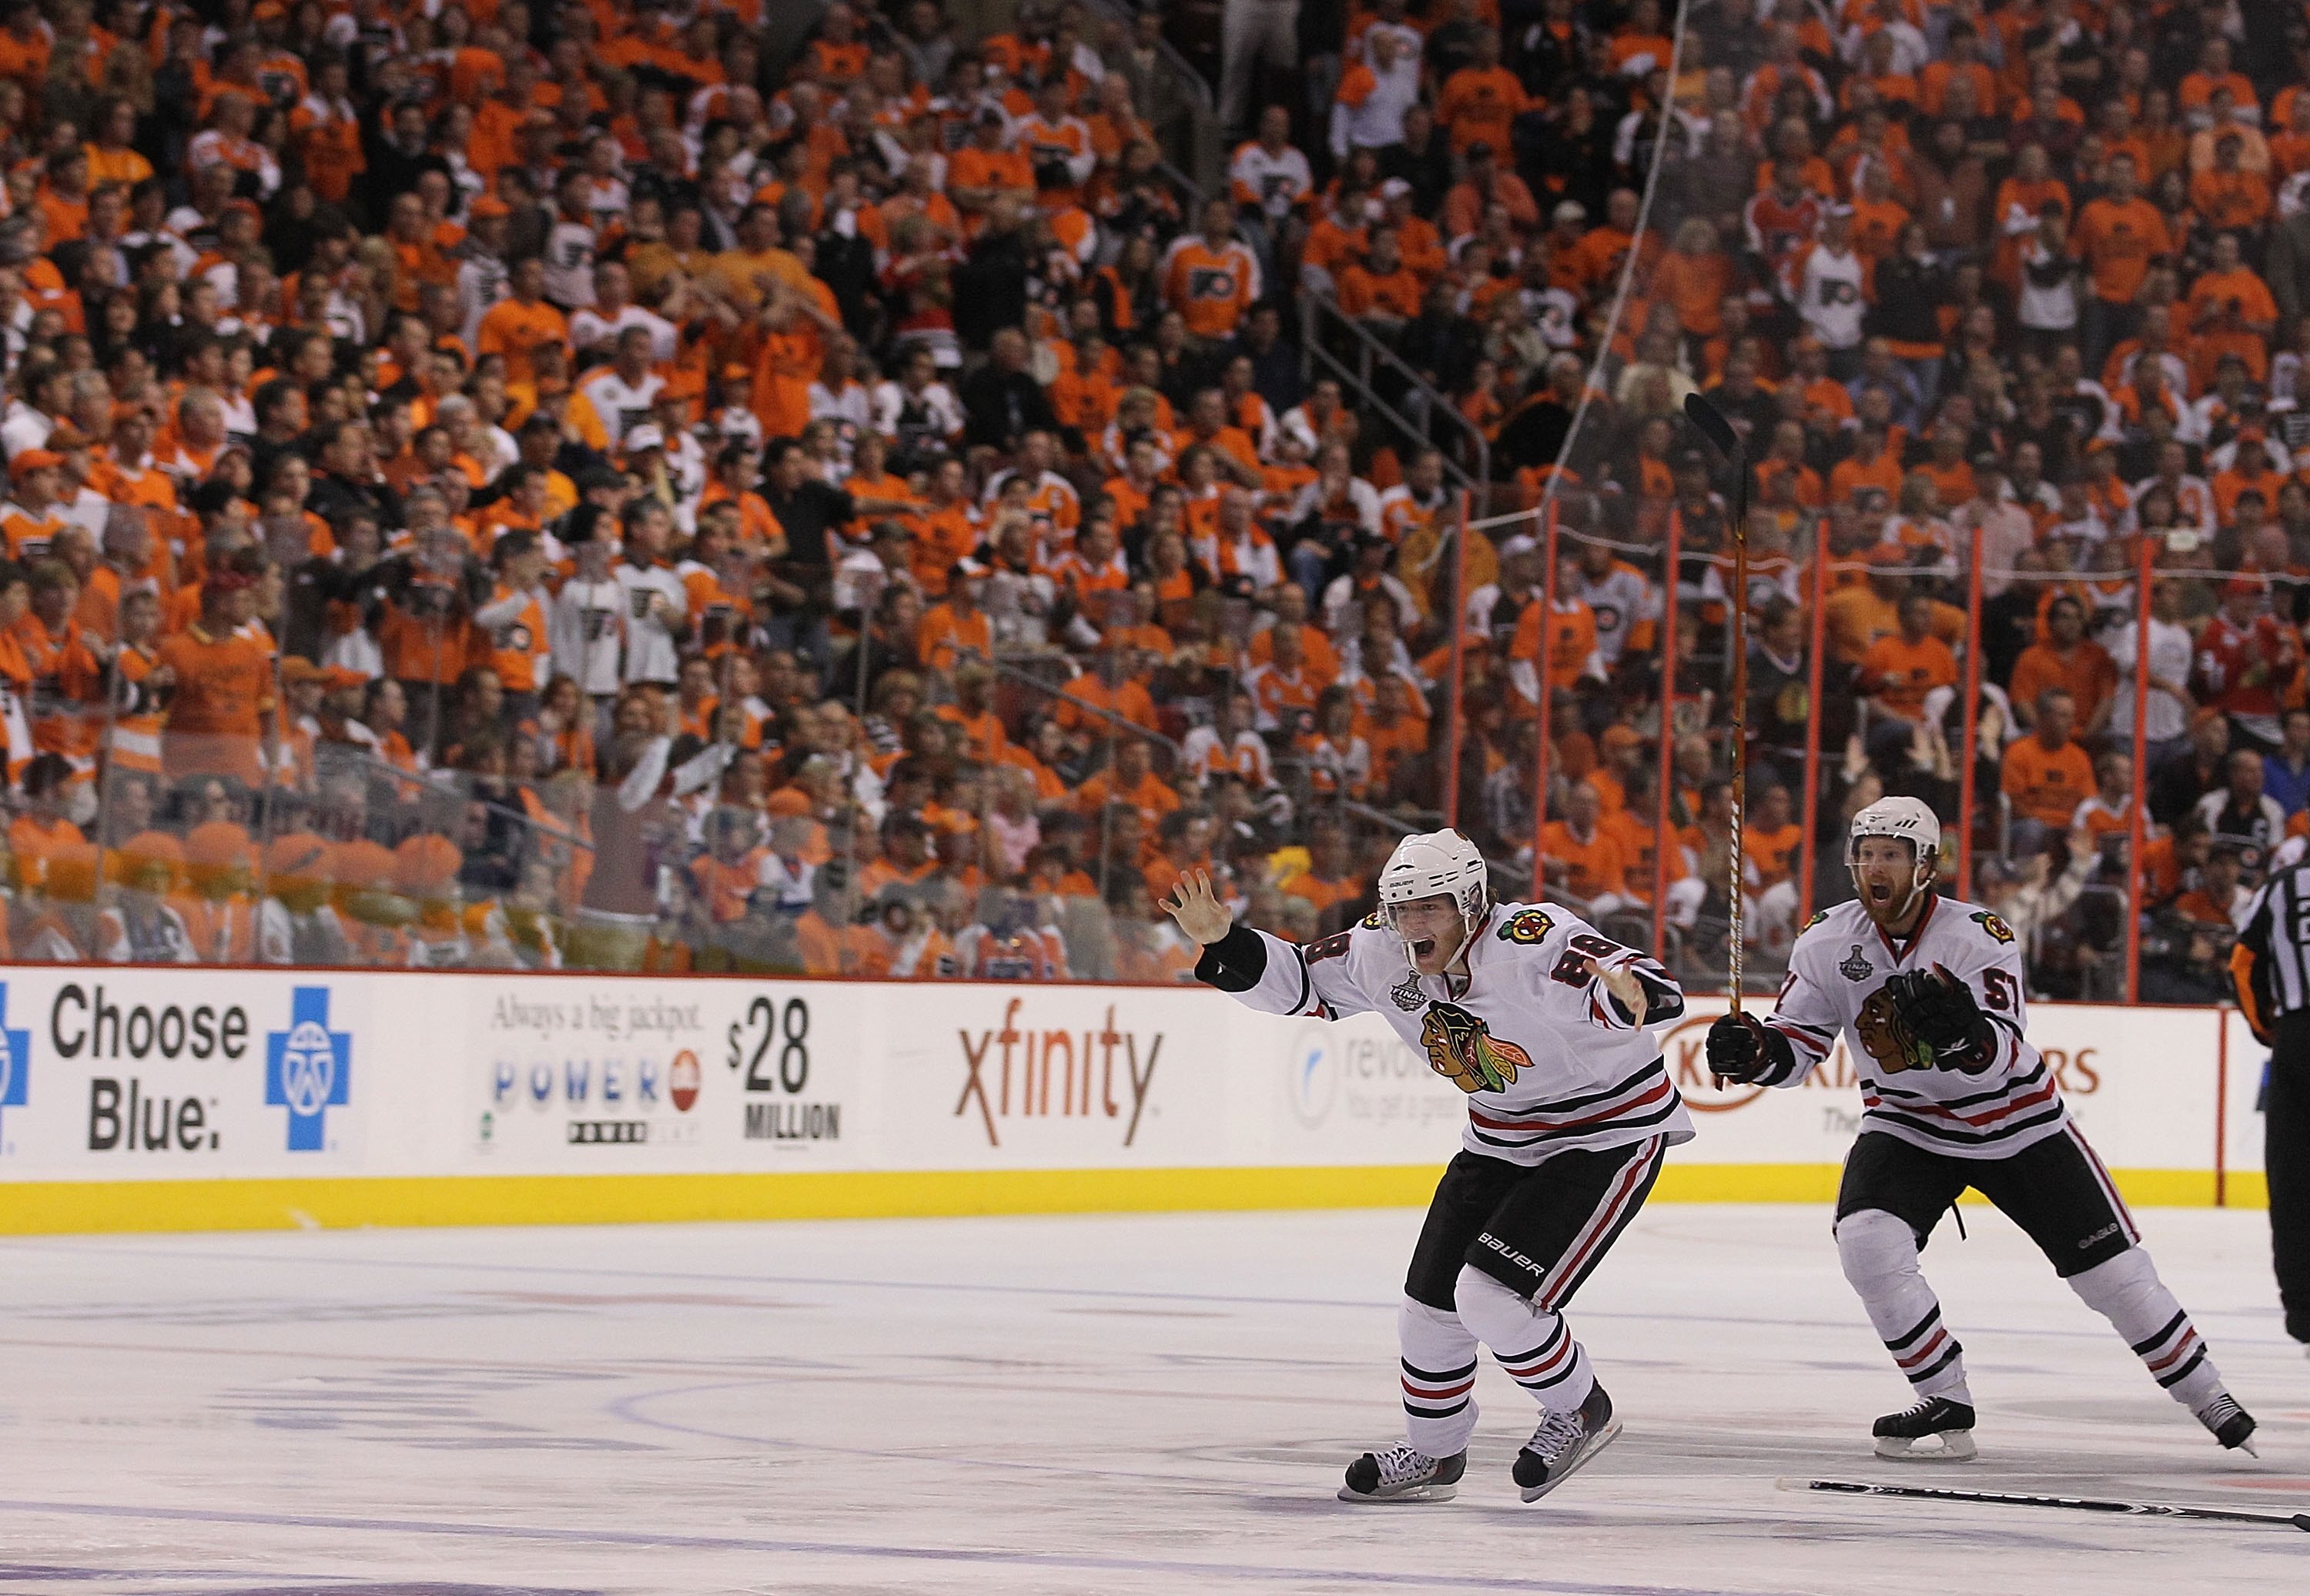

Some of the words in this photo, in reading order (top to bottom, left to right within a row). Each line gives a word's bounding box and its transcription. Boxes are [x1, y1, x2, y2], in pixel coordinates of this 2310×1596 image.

[1389, 879, 1415, 888] BAUER
[1551, 934, 1622, 989] 88
[490, 993, 565, 1039] Always
[572, 1004, 584, 1030] a
[590, 994, 621, 1041] big
[1392, 988, 1425, 1002] FINAL
[1982, 967, 2019, 1019] 57
[51, 983, 249, 1059] Choose
[953, 997, 1164, 1147] xfinity
[89, 1078, 220, 1151] Blue.
[745, 1103, 841, 1139] MILLION
[1478, 1232, 1545, 1277] BAUER
